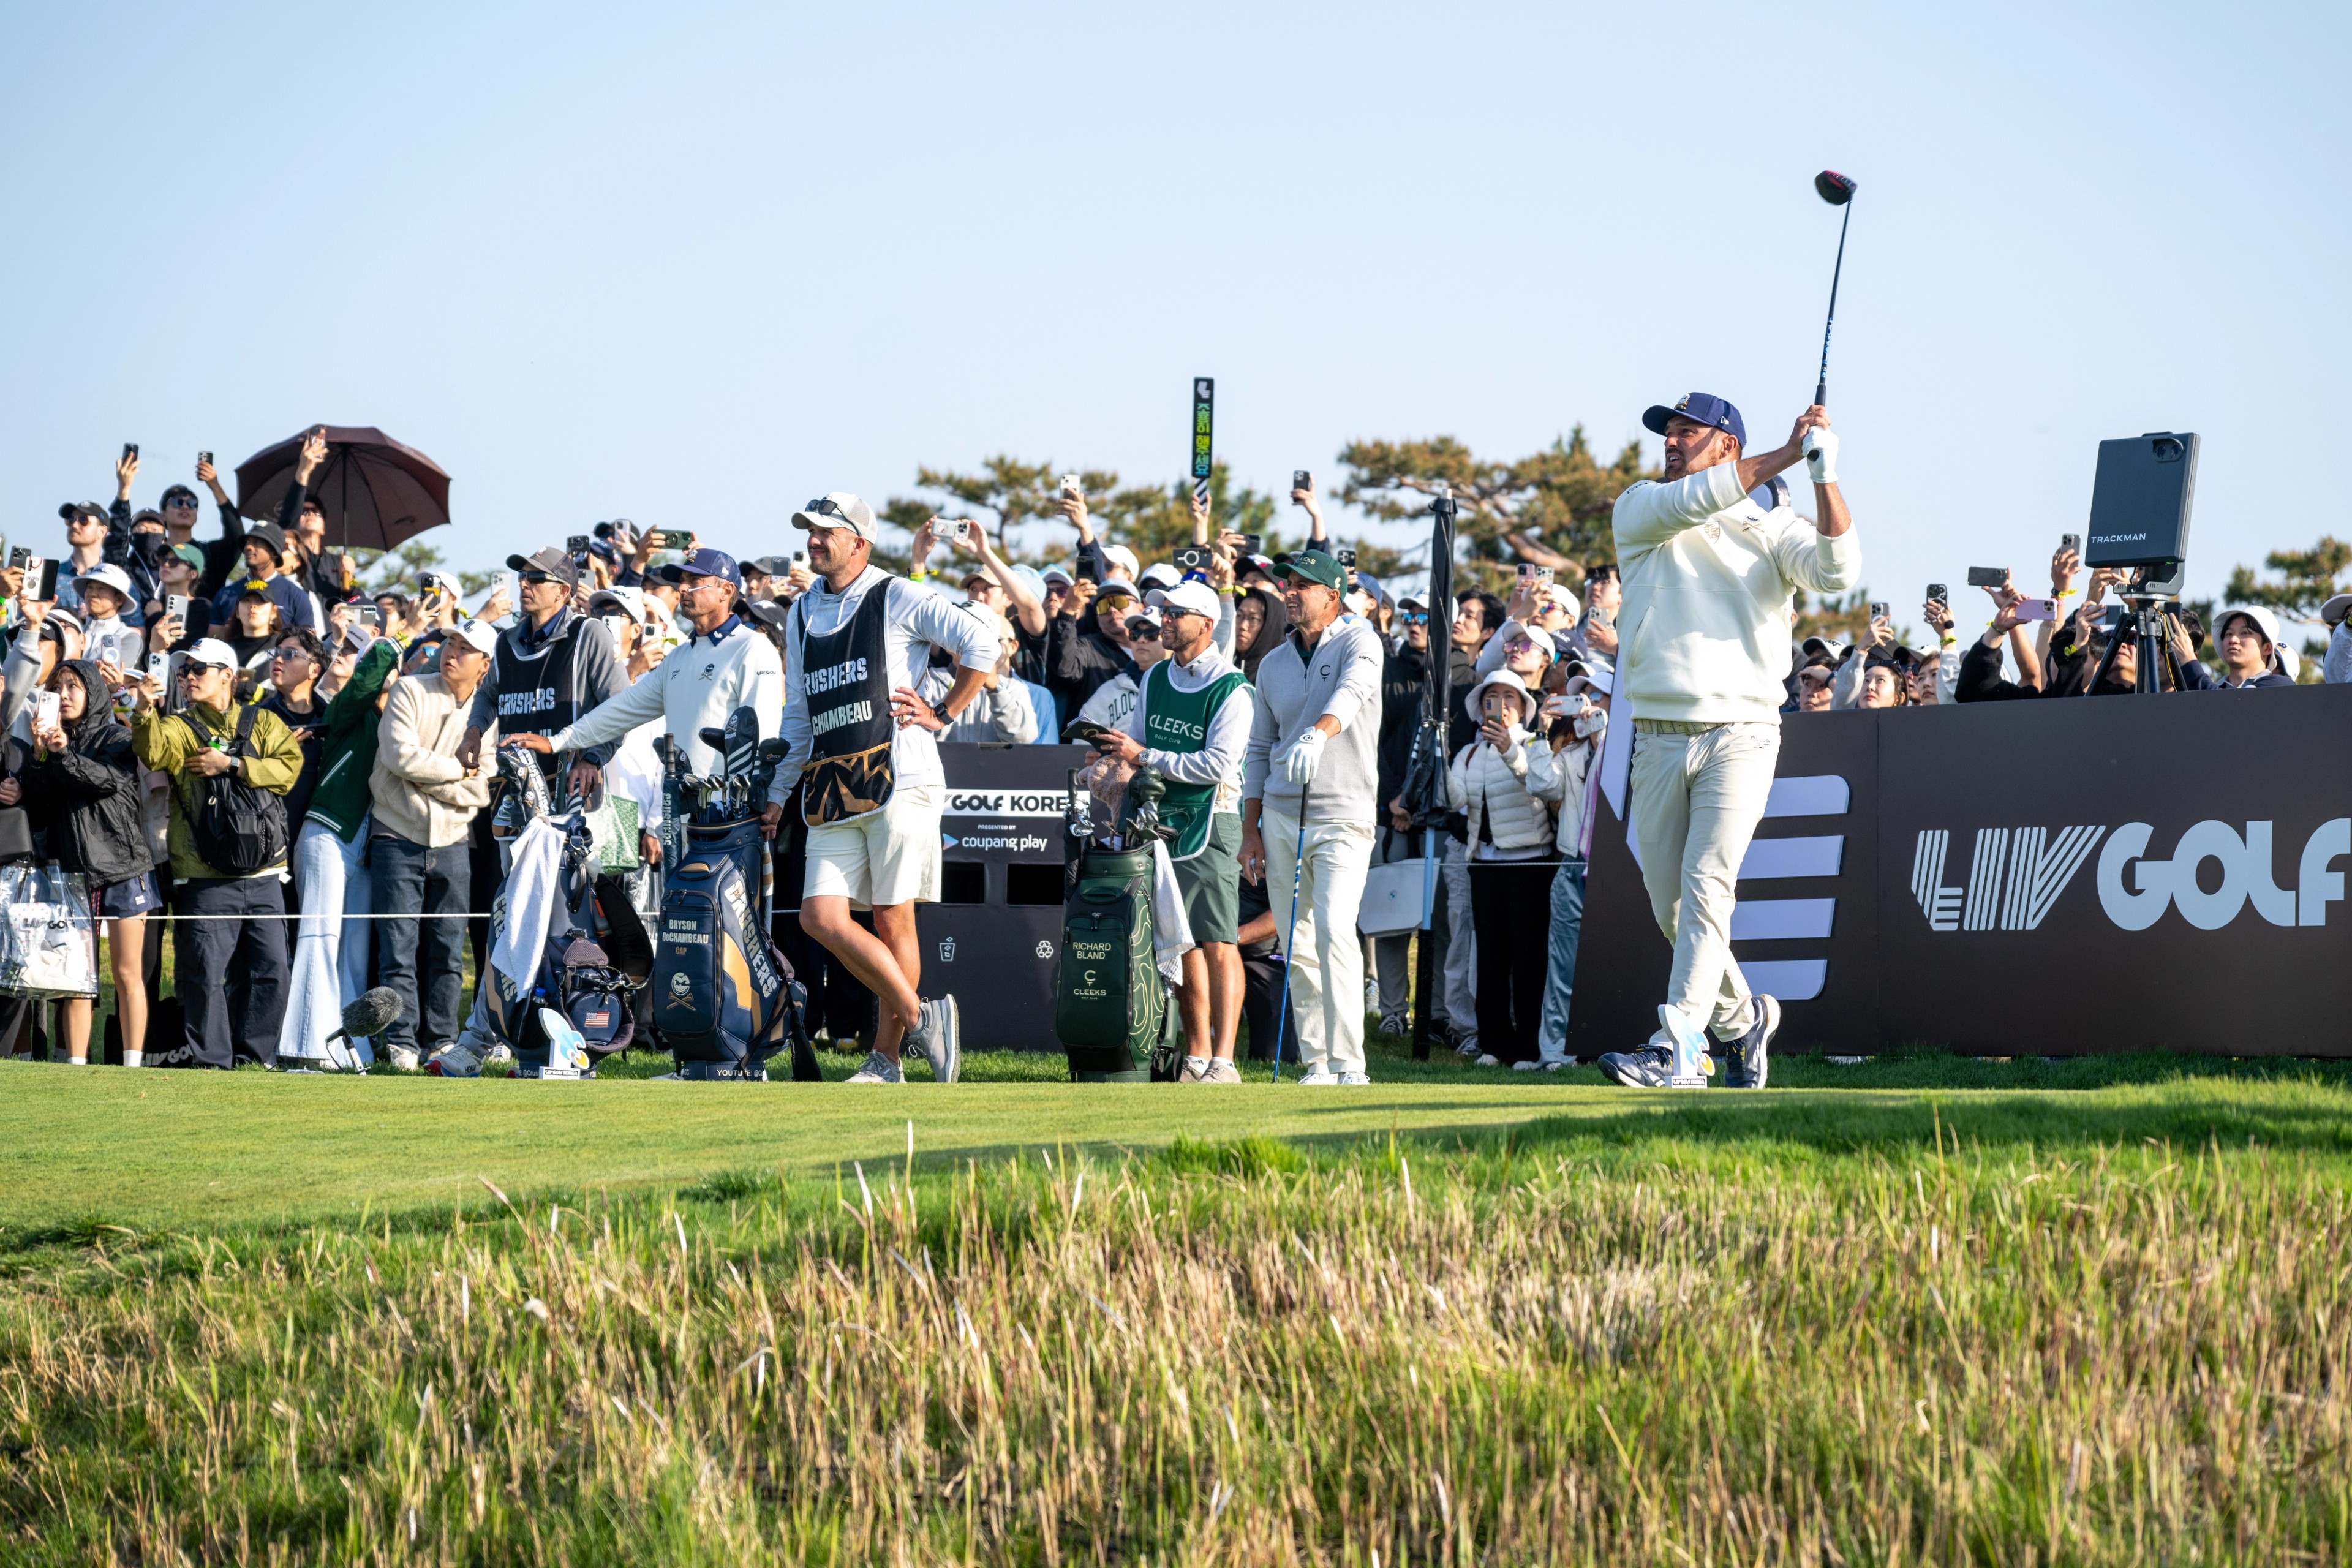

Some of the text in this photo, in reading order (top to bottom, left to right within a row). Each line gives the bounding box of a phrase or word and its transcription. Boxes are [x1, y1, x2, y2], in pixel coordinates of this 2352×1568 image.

[1196, 402, 1210, 475] 조용히 해주세요
[2091, 533, 2146, 543] TRACKMAN
[804, 657, 867, 695] RUSHERS
[498, 687, 555, 715] CRUSHERS
[1108, 692, 1136, 727] BLOC
[812, 700, 872, 736] CHAMBEAU
[1149, 714, 1204, 740] CLEEKS
[951, 794, 1004, 811] GOLF
[1010, 796, 1068, 812] KORE
[962, 834, 1047, 851] coupang play
[669, 919, 697, 930] BRYSON
[662, 932, 709, 944] DeCHAMBEAU
[724, 879, 777, 998] CRUSHERS
[1073, 942, 1112, 951] RICHARD
[676, 946, 687, 955] CAP
